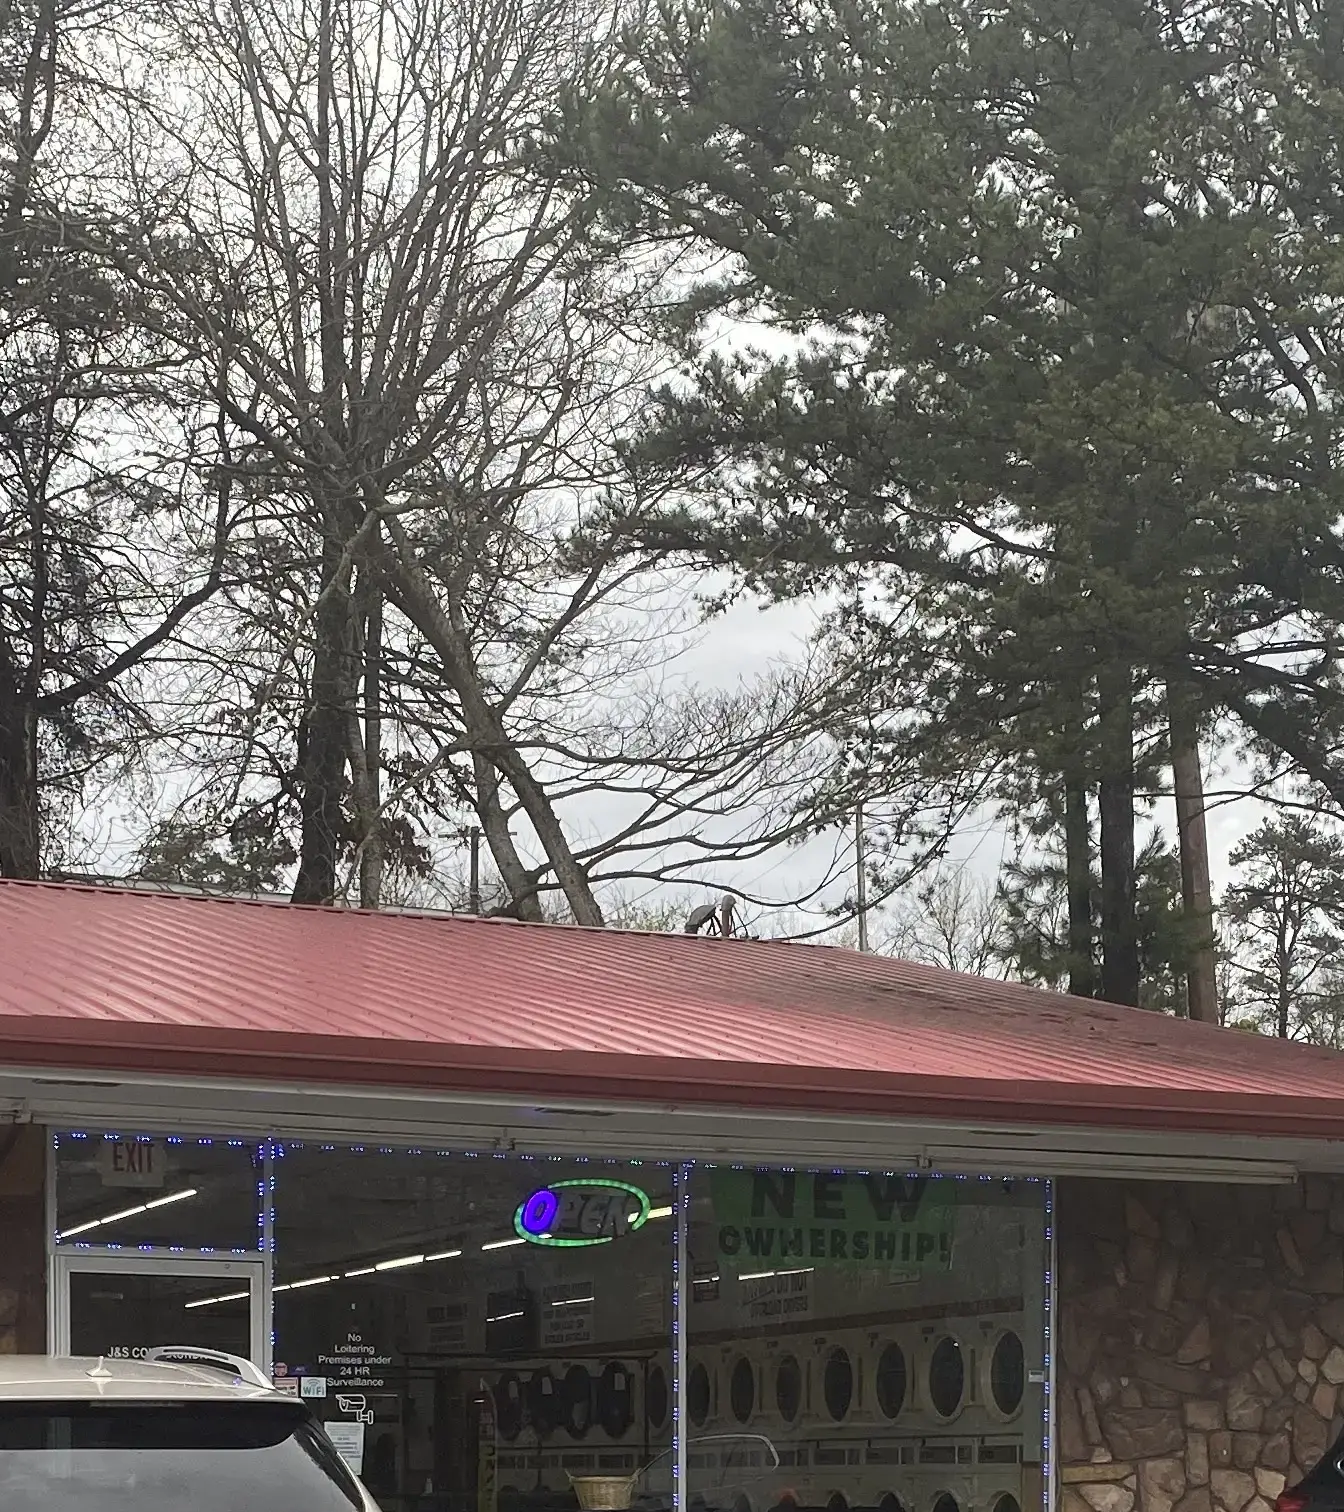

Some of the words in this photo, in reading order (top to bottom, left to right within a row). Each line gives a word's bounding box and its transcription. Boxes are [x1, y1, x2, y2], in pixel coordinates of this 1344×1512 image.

[113, 1142, 155, 1173] EXIT
[751, 1171, 929, 1222] NEW
[523, 1188, 629, 1236] OPEN
[718, 1225, 952, 1263] OWNERSHIP!
[347, 1333, 362, 1342] No
[107, 1346, 129, 1358] J&S
[334, 1344, 375, 1355] Loitering
[318, 1355, 362, 1365] Premises
[364, 1355, 392, 1365] under
[340, 1366, 352, 1375] 24
[354, 1366, 370, 1375] HR
[326, 1377, 384, 1387] Surveillance
